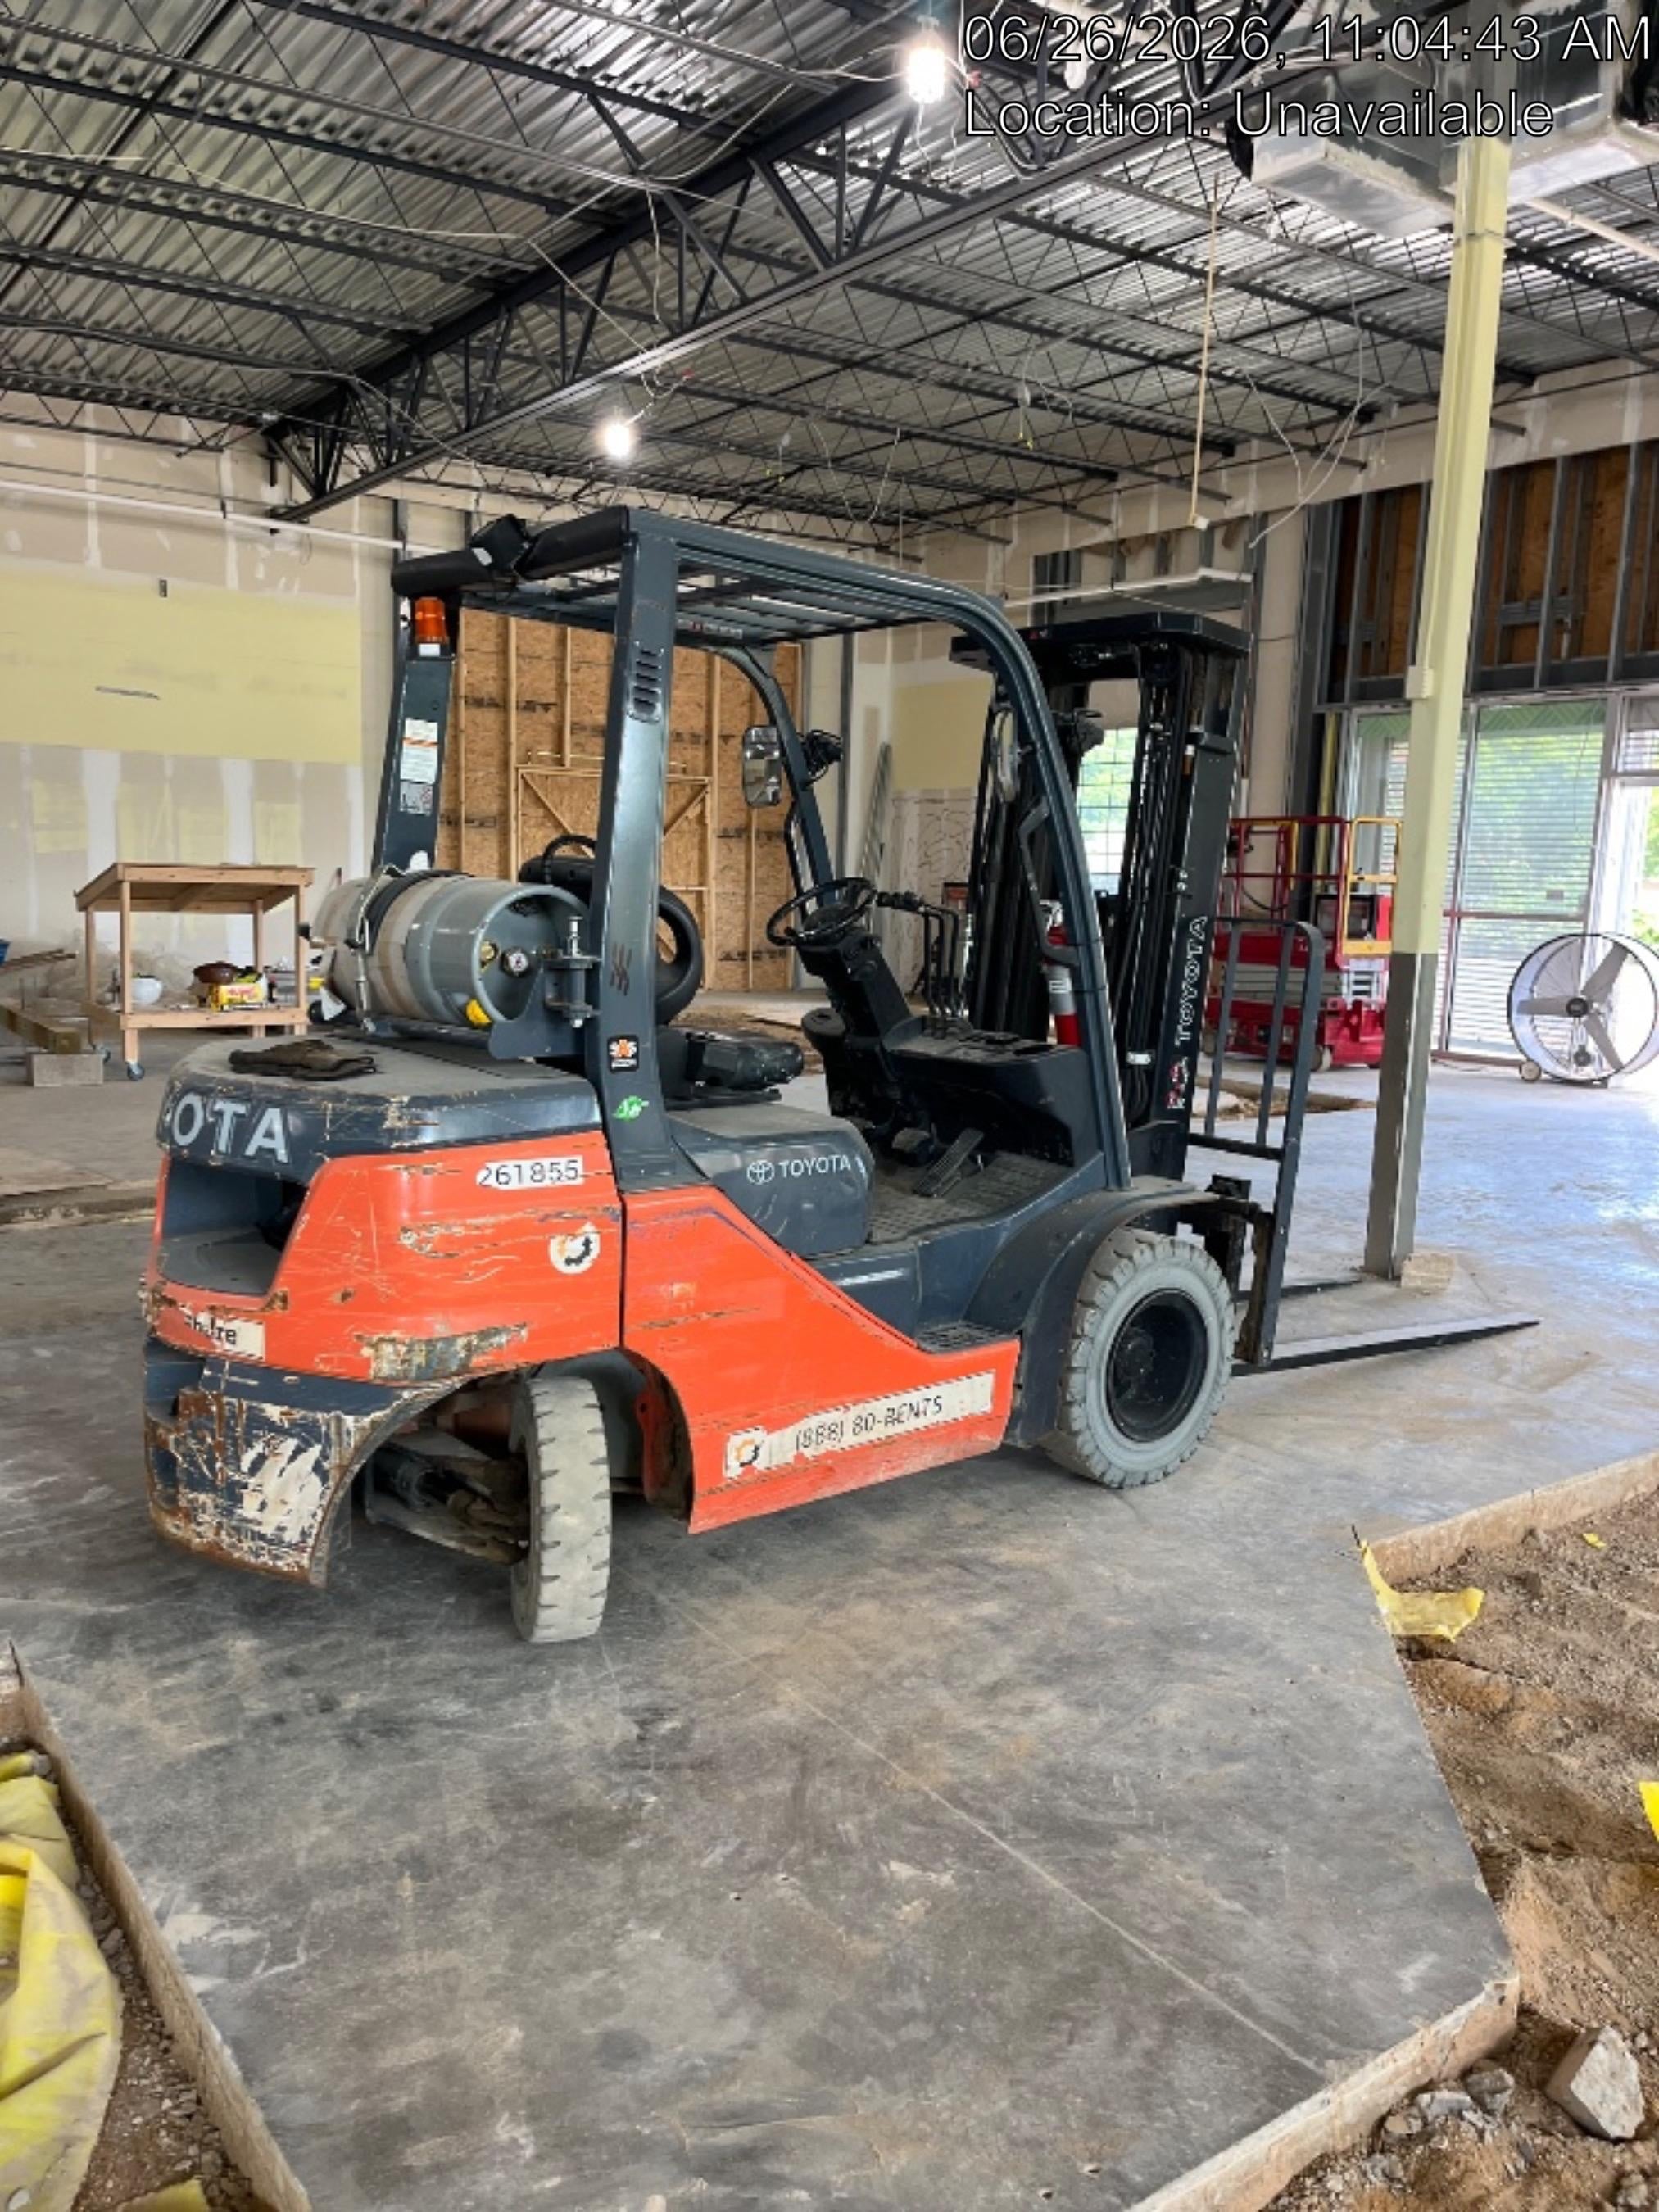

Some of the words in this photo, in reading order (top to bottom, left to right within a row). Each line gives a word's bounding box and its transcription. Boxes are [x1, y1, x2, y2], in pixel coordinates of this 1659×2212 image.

[1174, 916, 1208, 1046] TOYOTA
[478, 1158, 578, 1185] 261855
[779, 1154, 852, 1178] TOYOTA
[795, 1419, 845, 1451] (888)
